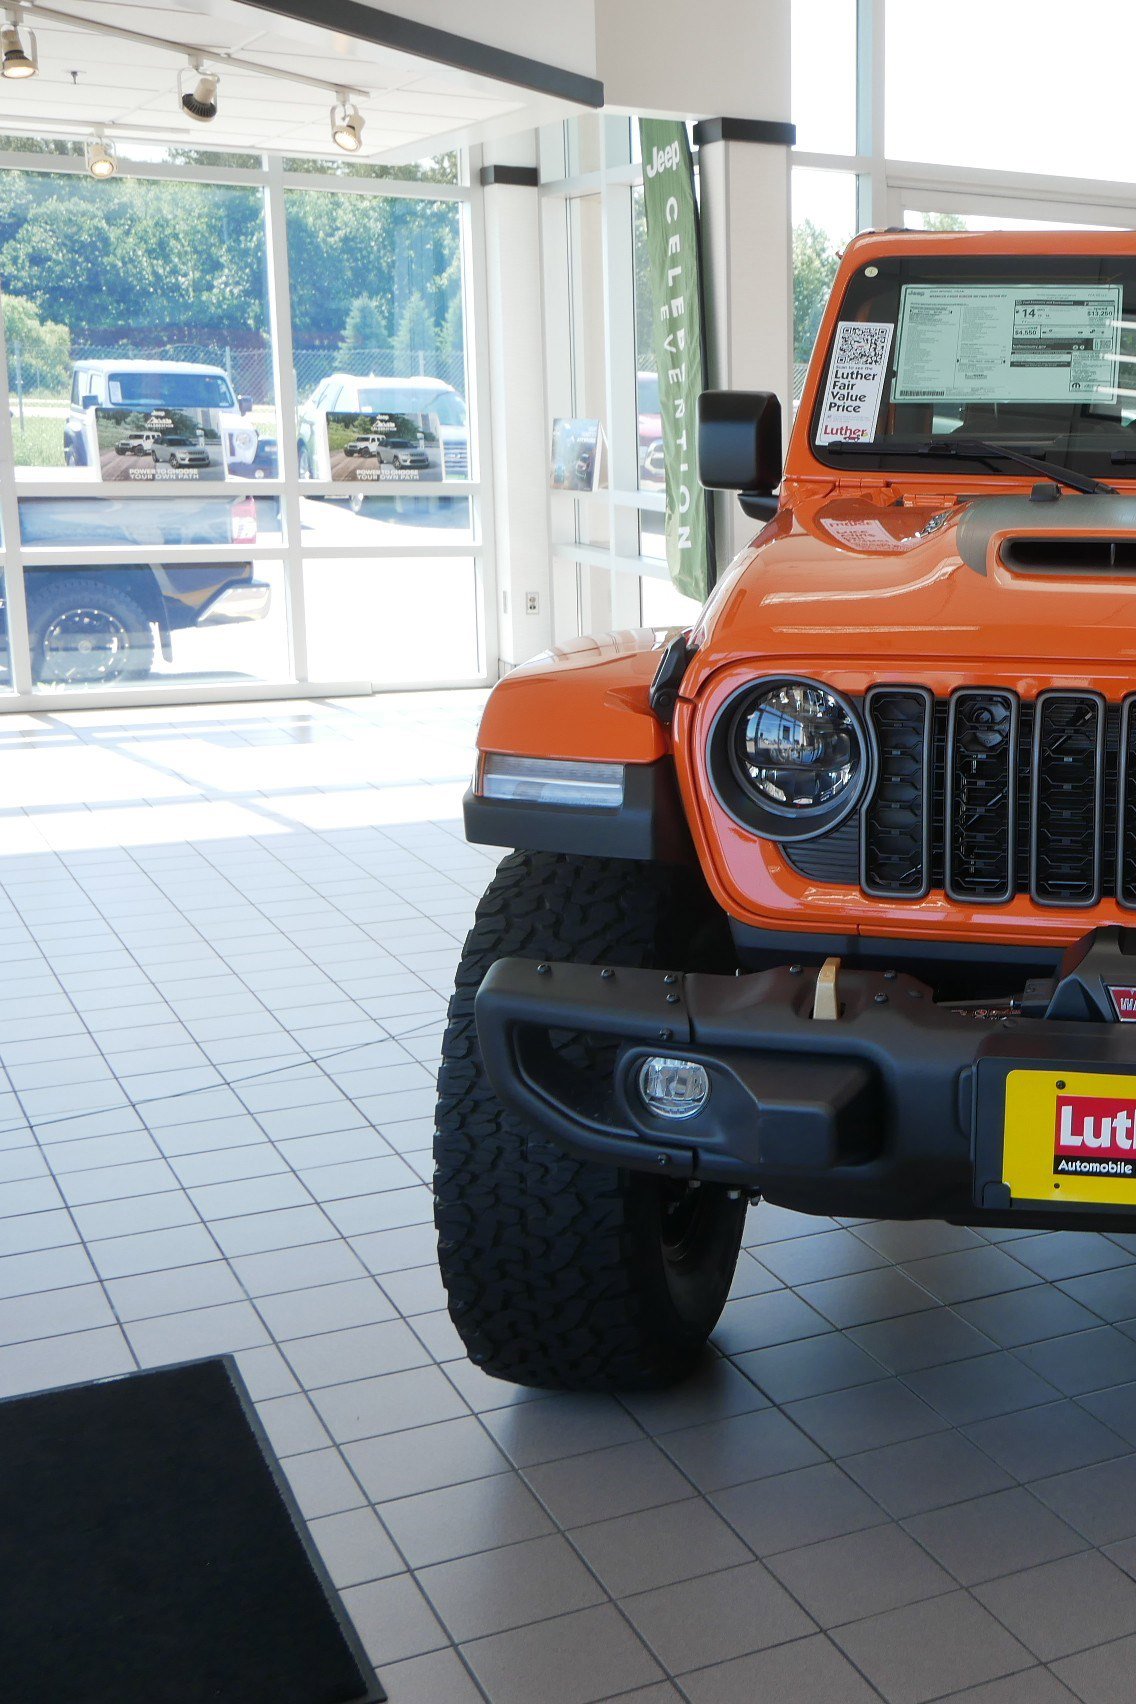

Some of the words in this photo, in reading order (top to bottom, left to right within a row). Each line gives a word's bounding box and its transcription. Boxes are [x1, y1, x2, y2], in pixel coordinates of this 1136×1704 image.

[647, 140, 680, 179] Jeep
[1022, 309, 1036, 318] 14
[834, 369, 877, 381] Luther
[832, 381, 856, 391] Fair
[831, 391, 867, 403] Value
[828, 402, 861, 413] Price
[823, 425, 867, 437] Luther
[1057, 1159, 1133, 1175] Automobile
